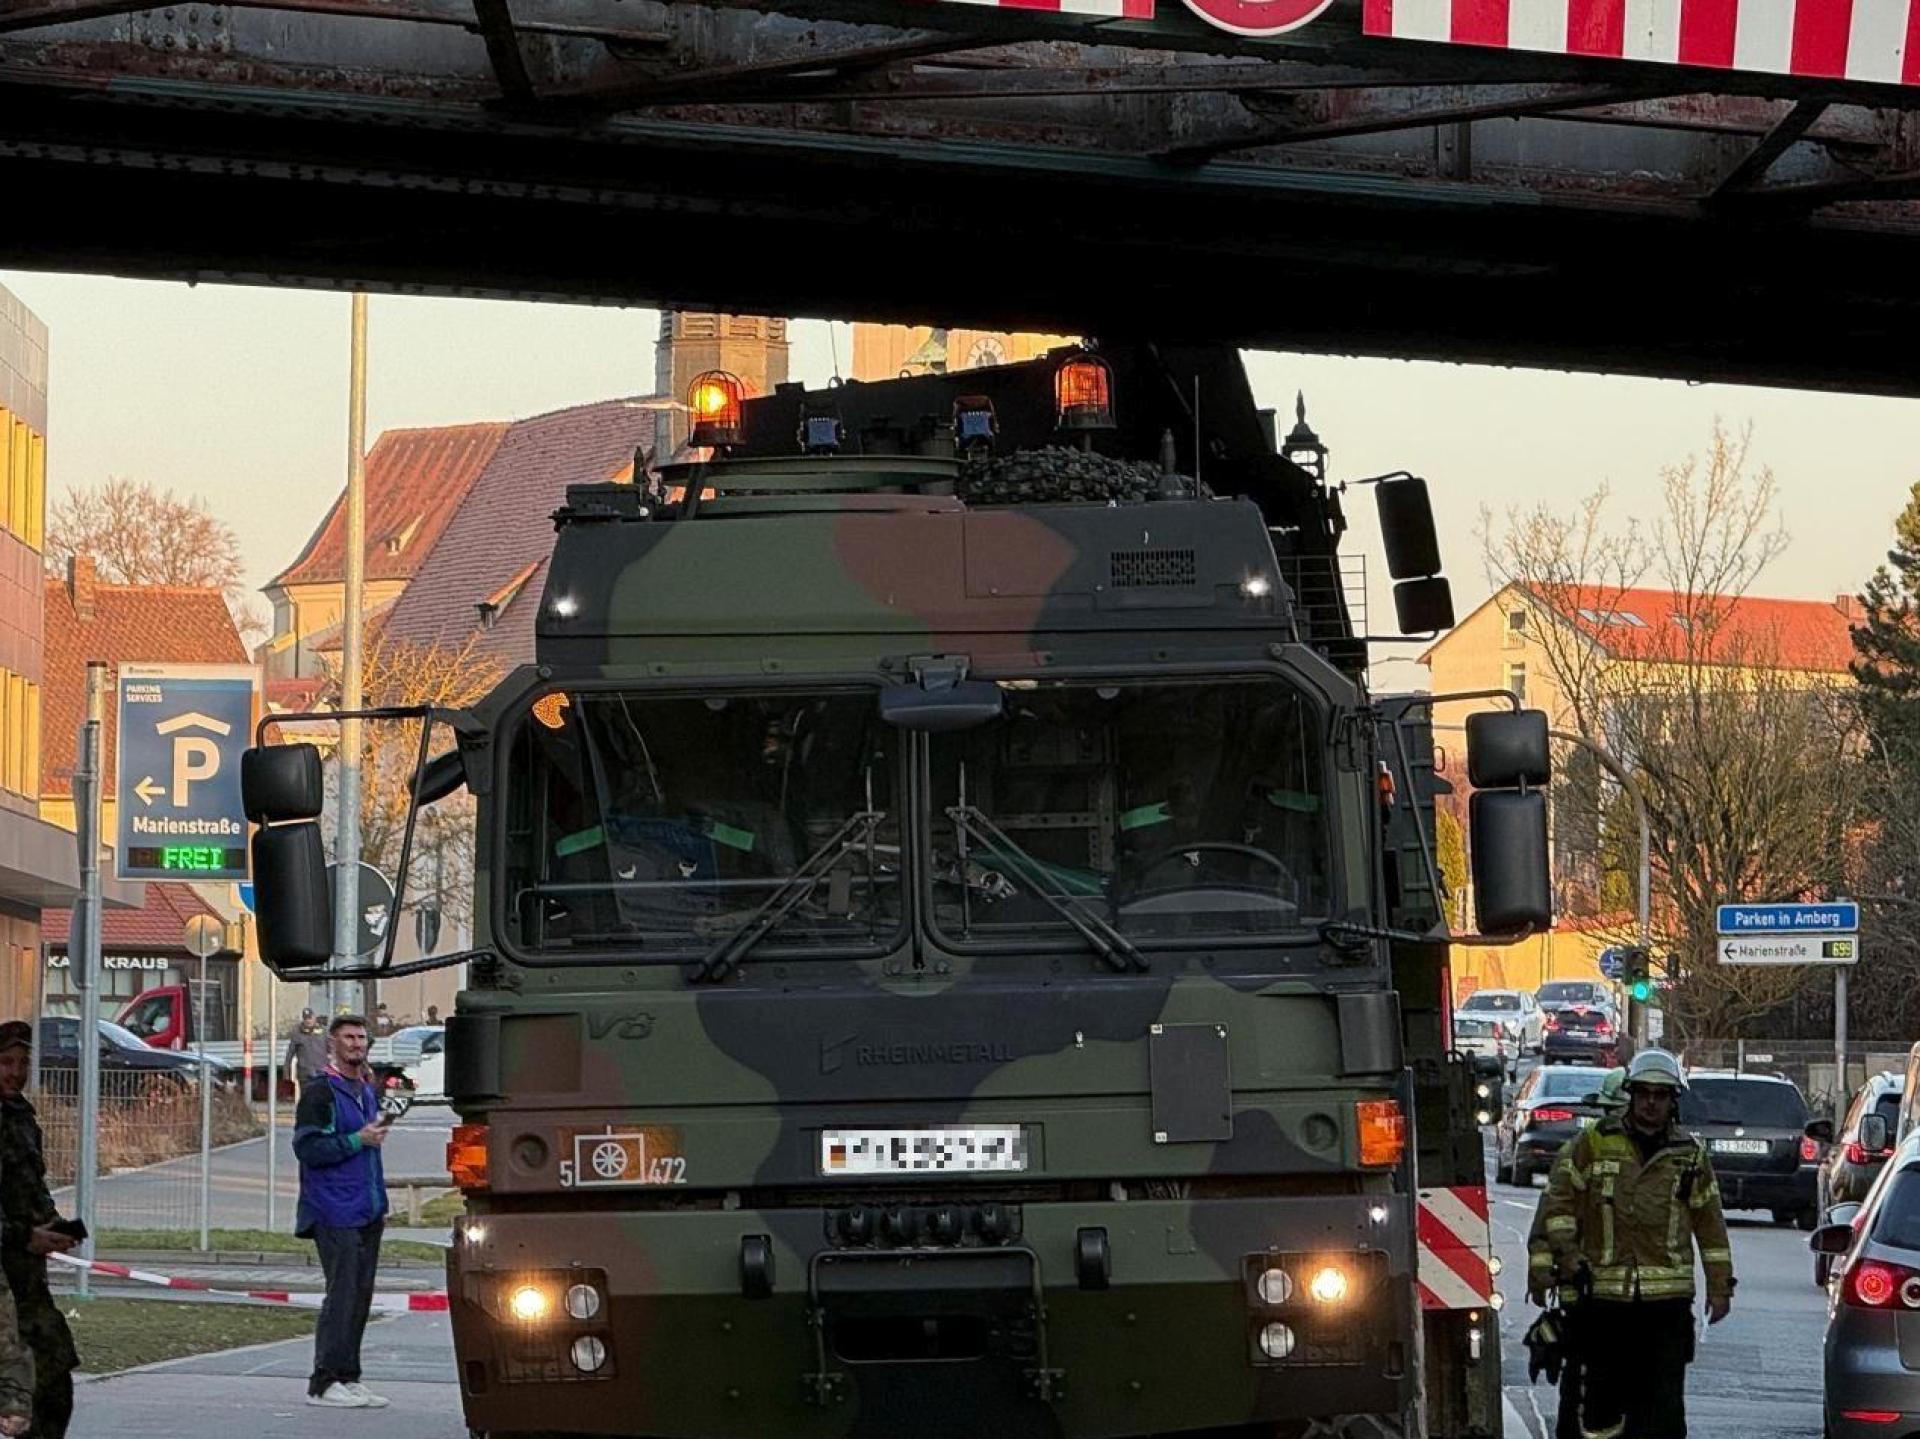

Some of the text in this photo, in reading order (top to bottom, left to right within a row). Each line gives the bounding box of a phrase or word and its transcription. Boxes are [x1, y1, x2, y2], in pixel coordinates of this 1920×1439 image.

[132, 816, 241, 835] Marienstraße
[163, 846, 222, 870] FREI
[1735, 911, 1840, 926] Parken in Amberg
[104, 957, 169, 969] KRAUS
[856, 1042, 1016, 1066] RHEINMETALL
[559, 1160, 573, 1187] 5
[649, 1156, 688, 1184] 472
